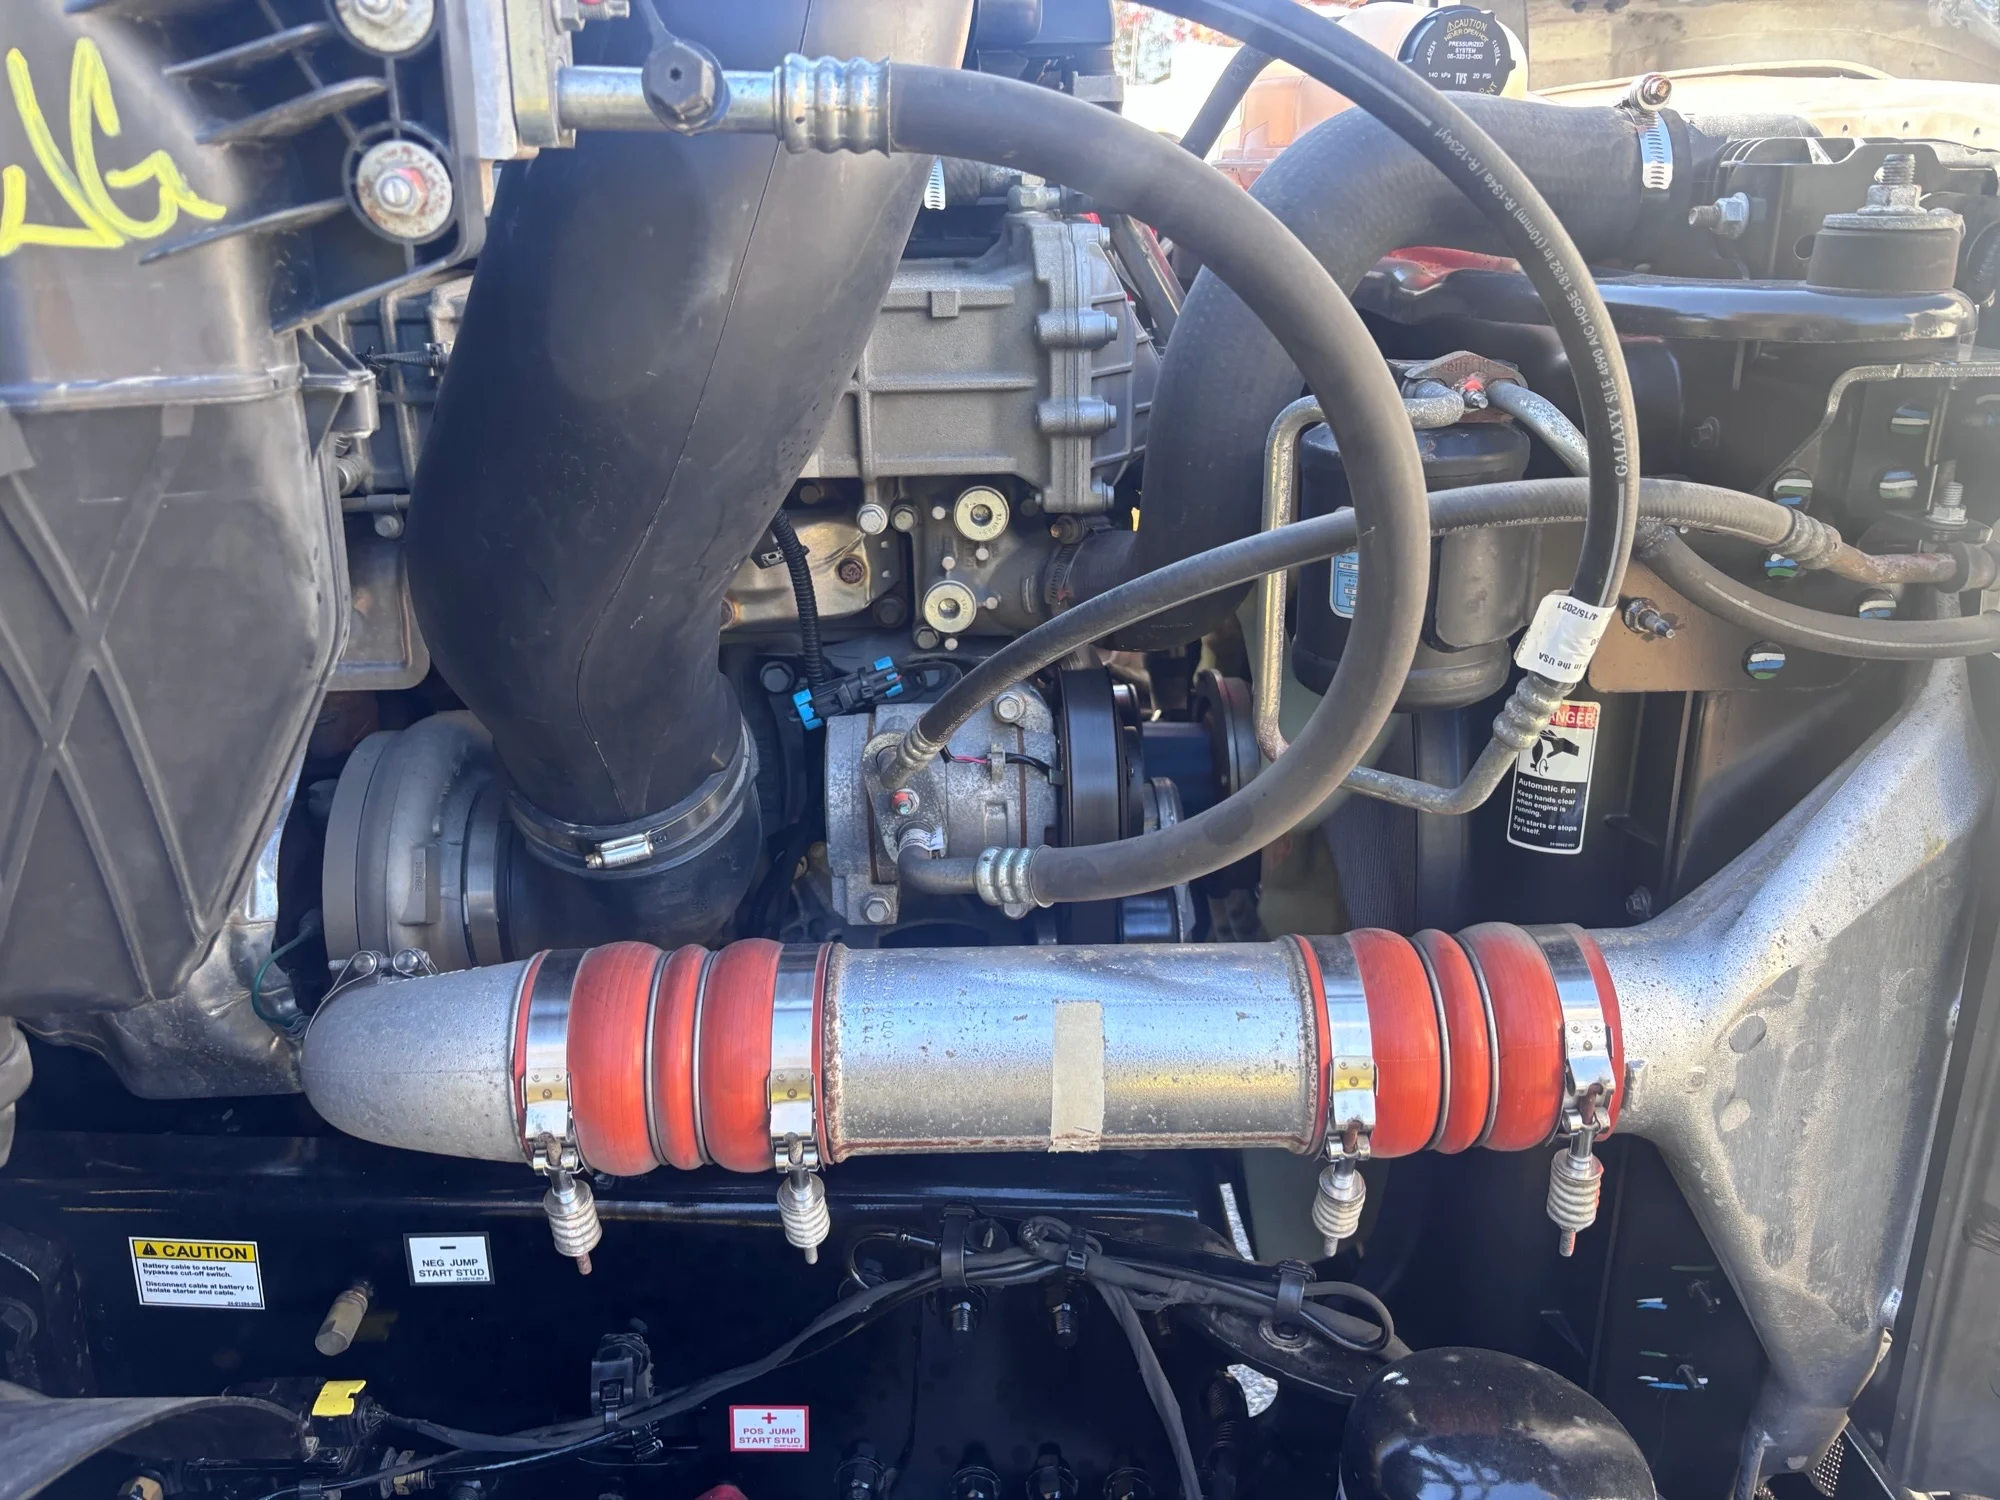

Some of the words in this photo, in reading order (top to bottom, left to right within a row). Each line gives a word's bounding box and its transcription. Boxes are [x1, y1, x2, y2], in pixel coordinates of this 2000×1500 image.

[1454, 18, 1488, 31] CAUTION
[1444, 28, 1463, 41] NEVER
[1464, 28, 1478, 37] OPEN
[1478, 31, 1489, 42] HOT
[1427, 40, 1437, 57] OPEN
[1455, 73, 1468, 84] TVS
[1434, 127, 1480, 171] R-1234yf
[1484, 172, 1517, 211] R-134a
[1513, 207, 1548, 248] (10mm)
[1549, 260, 1572, 291] 13/32
[1567, 290, 1590, 325] HOSE
[1583, 325, 1600, 346] A/C
[1592, 348, 1609, 375] 4890
[1600, 377, 1619, 403] SLE
[1607, 407, 1629, 476] GALAXY
[1505, 517, 1538, 526] HOSE
[1557, 601, 1599, 621] 4/15/2021
[1539, 651, 1556, 666] USA
[1557, 660, 1572, 670] the
[1549, 710, 1594, 728] ANGER
[1518, 777, 1558, 793] Automatic
[1560, 785, 1576, 795] Fan
[1516, 798, 1533, 807] when
[1534, 801, 1558, 813] engine
[1517, 789, 1533, 799] Keep
[1534, 793, 1556, 803] hands
[1558, 797, 1576, 806] clear
[1515, 805, 1541, 817] running.
[1513, 823, 1520, 832] by
[1521, 826, 1541, 836] itself.
[1514, 815, 1525, 824] Fan
[1526, 819, 1546, 829] starts
[1557, 824, 1577, 832] stops
[162, 1245, 248, 1260] CAUTION
[142, 1262, 169, 1270] Battery
[422, 1259, 445, 1267] NEG
[450, 1258, 478, 1267] JUMP
[419, 1269, 453, 1277] START
[456, 1268, 485, 1276] STUD
